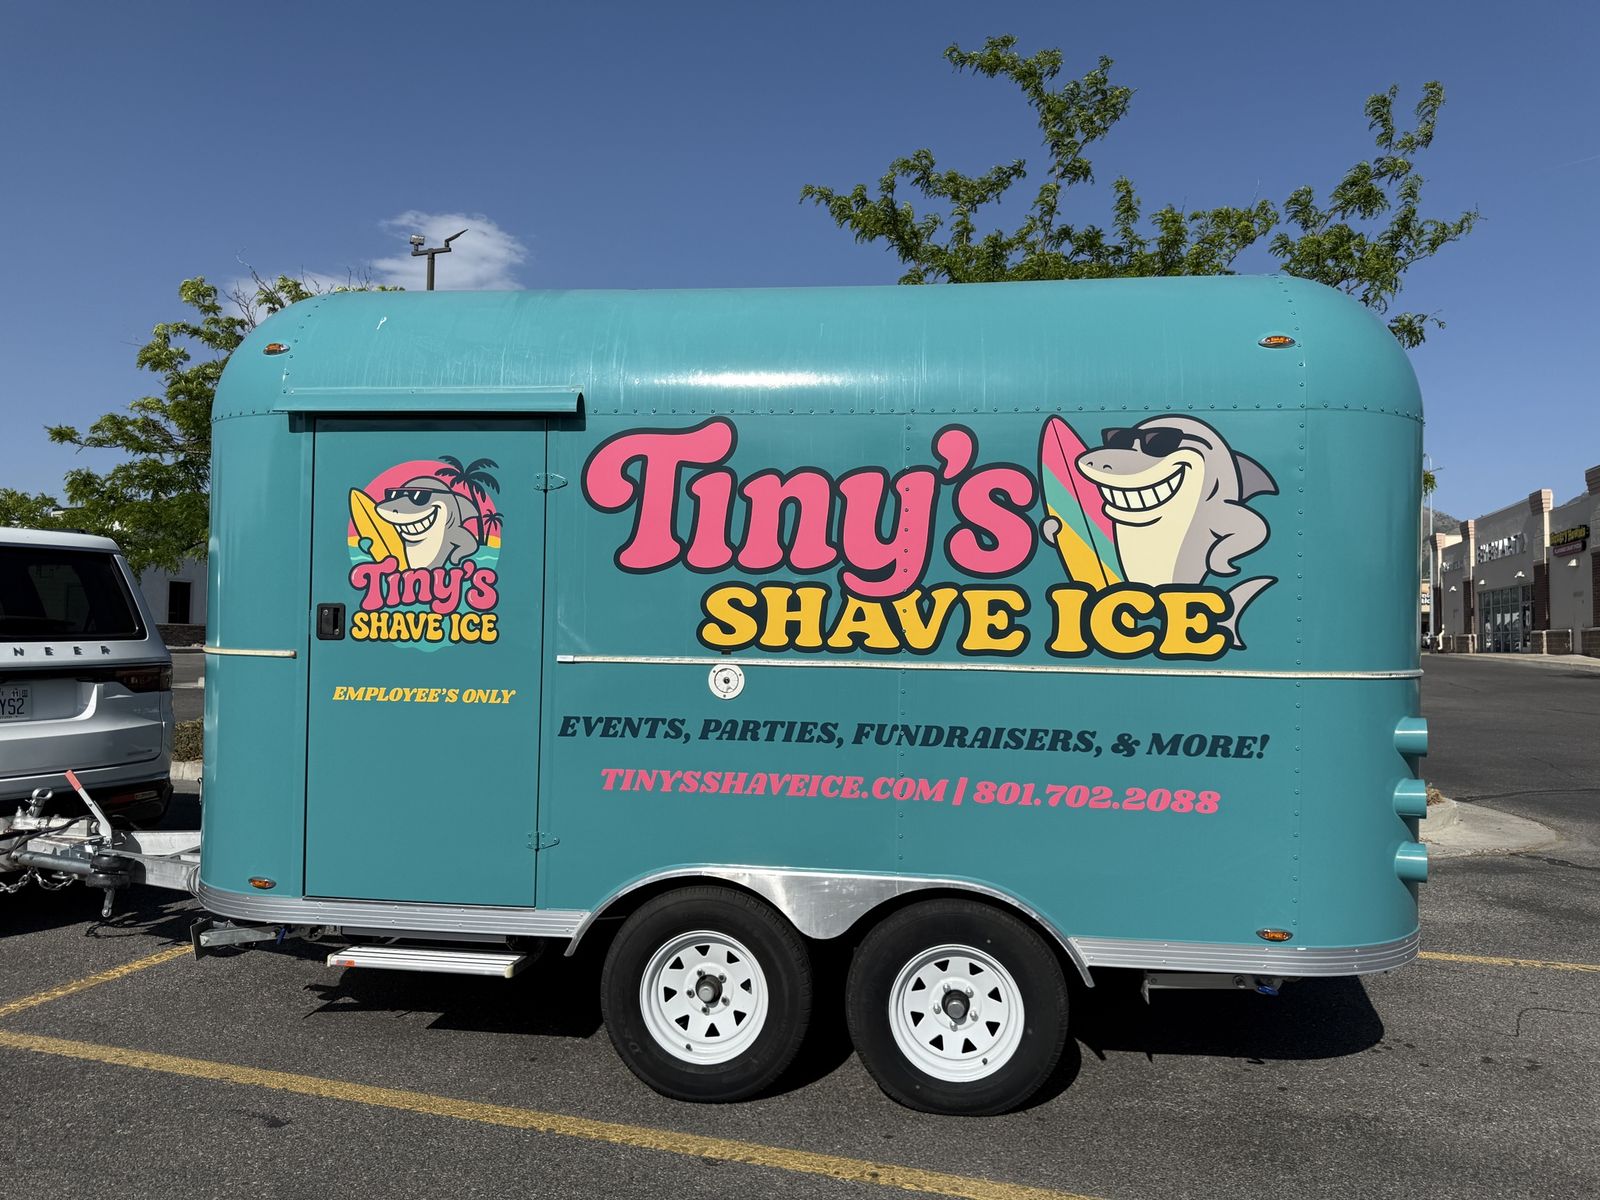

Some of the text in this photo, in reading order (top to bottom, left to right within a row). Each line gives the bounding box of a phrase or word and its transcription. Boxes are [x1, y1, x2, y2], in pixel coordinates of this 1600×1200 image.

[583, 417, 1035, 600] Tiny's
[349, 555, 500, 617] Tiny's
[350, 611, 499, 643] SHAVE ICE
[699, 582, 1234, 659] SHAVE ICE
[333, 687, 516, 704] EMPLOYEE'S ONLY
[557, 715, 1270, 760] EVENTS, PARTIES, FUNDRAISERS, & MORE!
[601, 768, 949, 802] TINYSSHAVEICE.COM
[973, 781, 1221, 815] 801.702.2088
